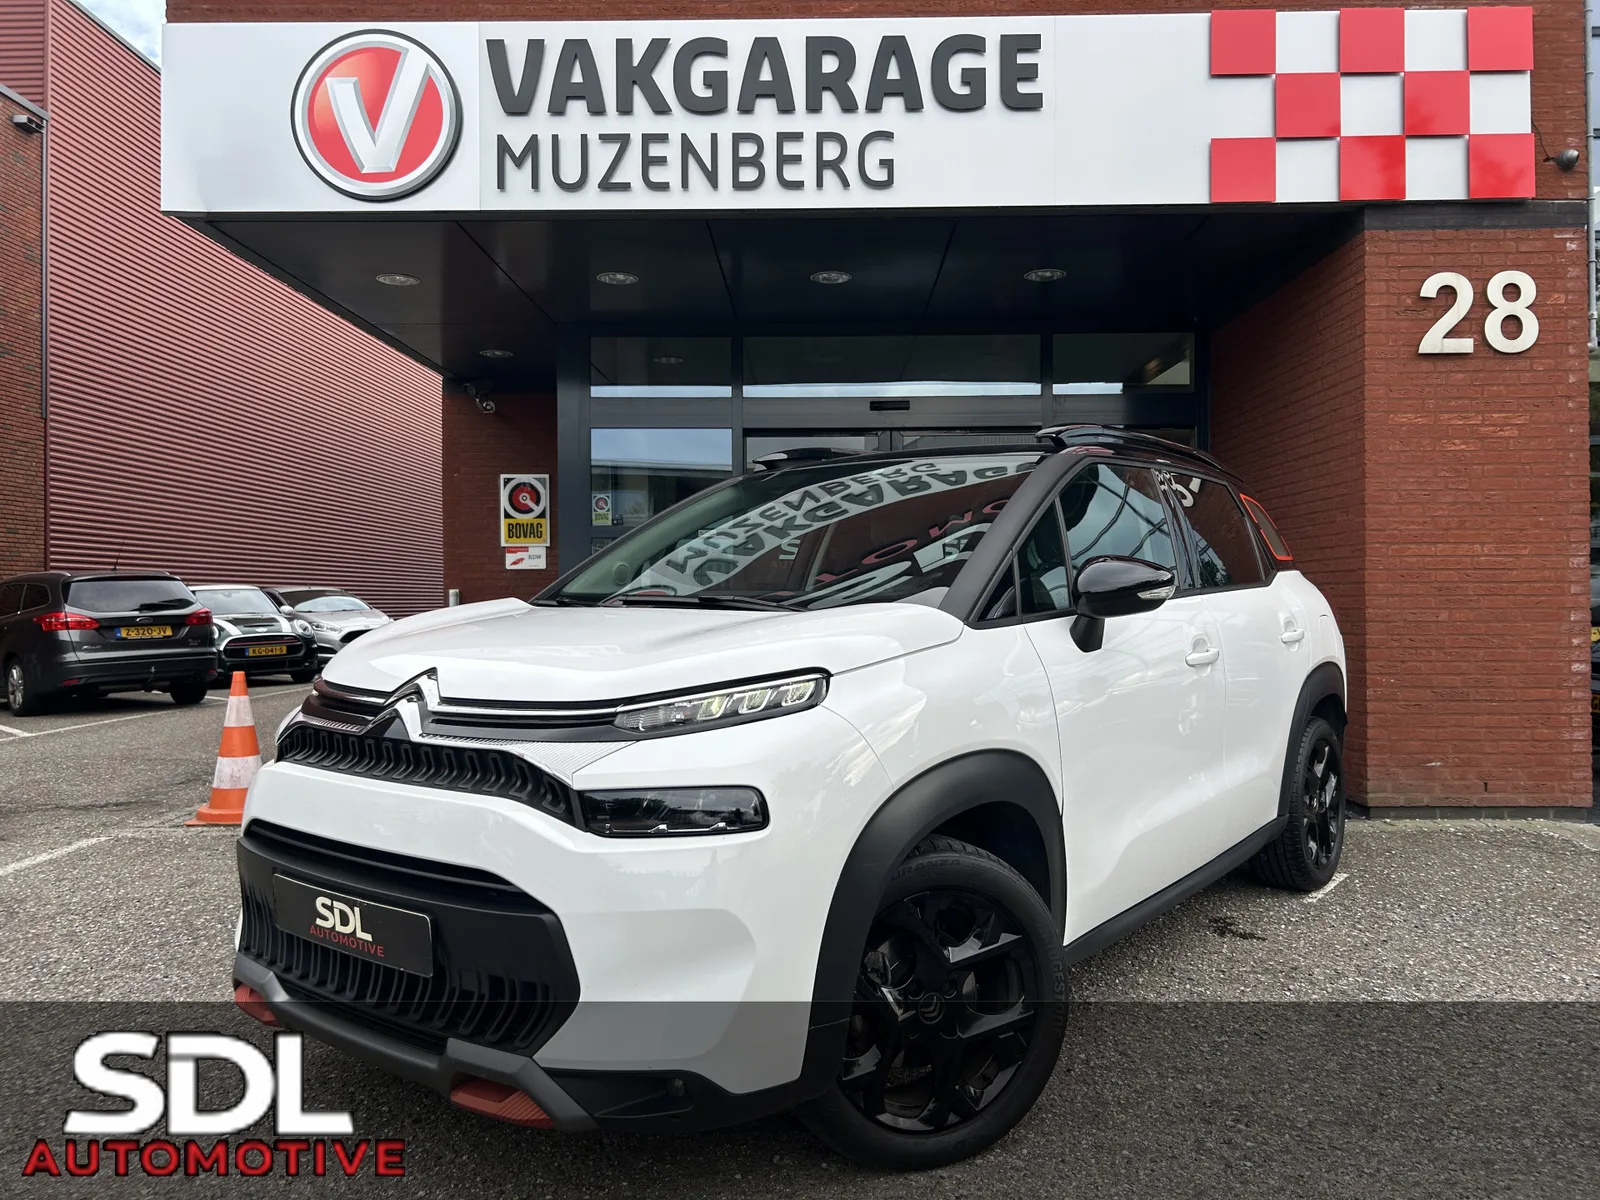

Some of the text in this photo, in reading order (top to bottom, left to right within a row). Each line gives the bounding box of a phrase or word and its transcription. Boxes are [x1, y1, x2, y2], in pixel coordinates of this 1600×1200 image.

[486, 34, 1044, 115] VAKGARAGE
[496, 131, 895, 192] MUZENBERG
[1418, 270, 1539, 354] 28
[507, 523, 543, 539] BOVAG
[125, 627, 167, 636] Z-320-JV
[252, 647, 284, 655] KG-041-S
[890, 859, 961, 882] URANZA
[315, 896, 373, 942] SDL
[309, 925, 385, 957] AUTOMOTIVE
